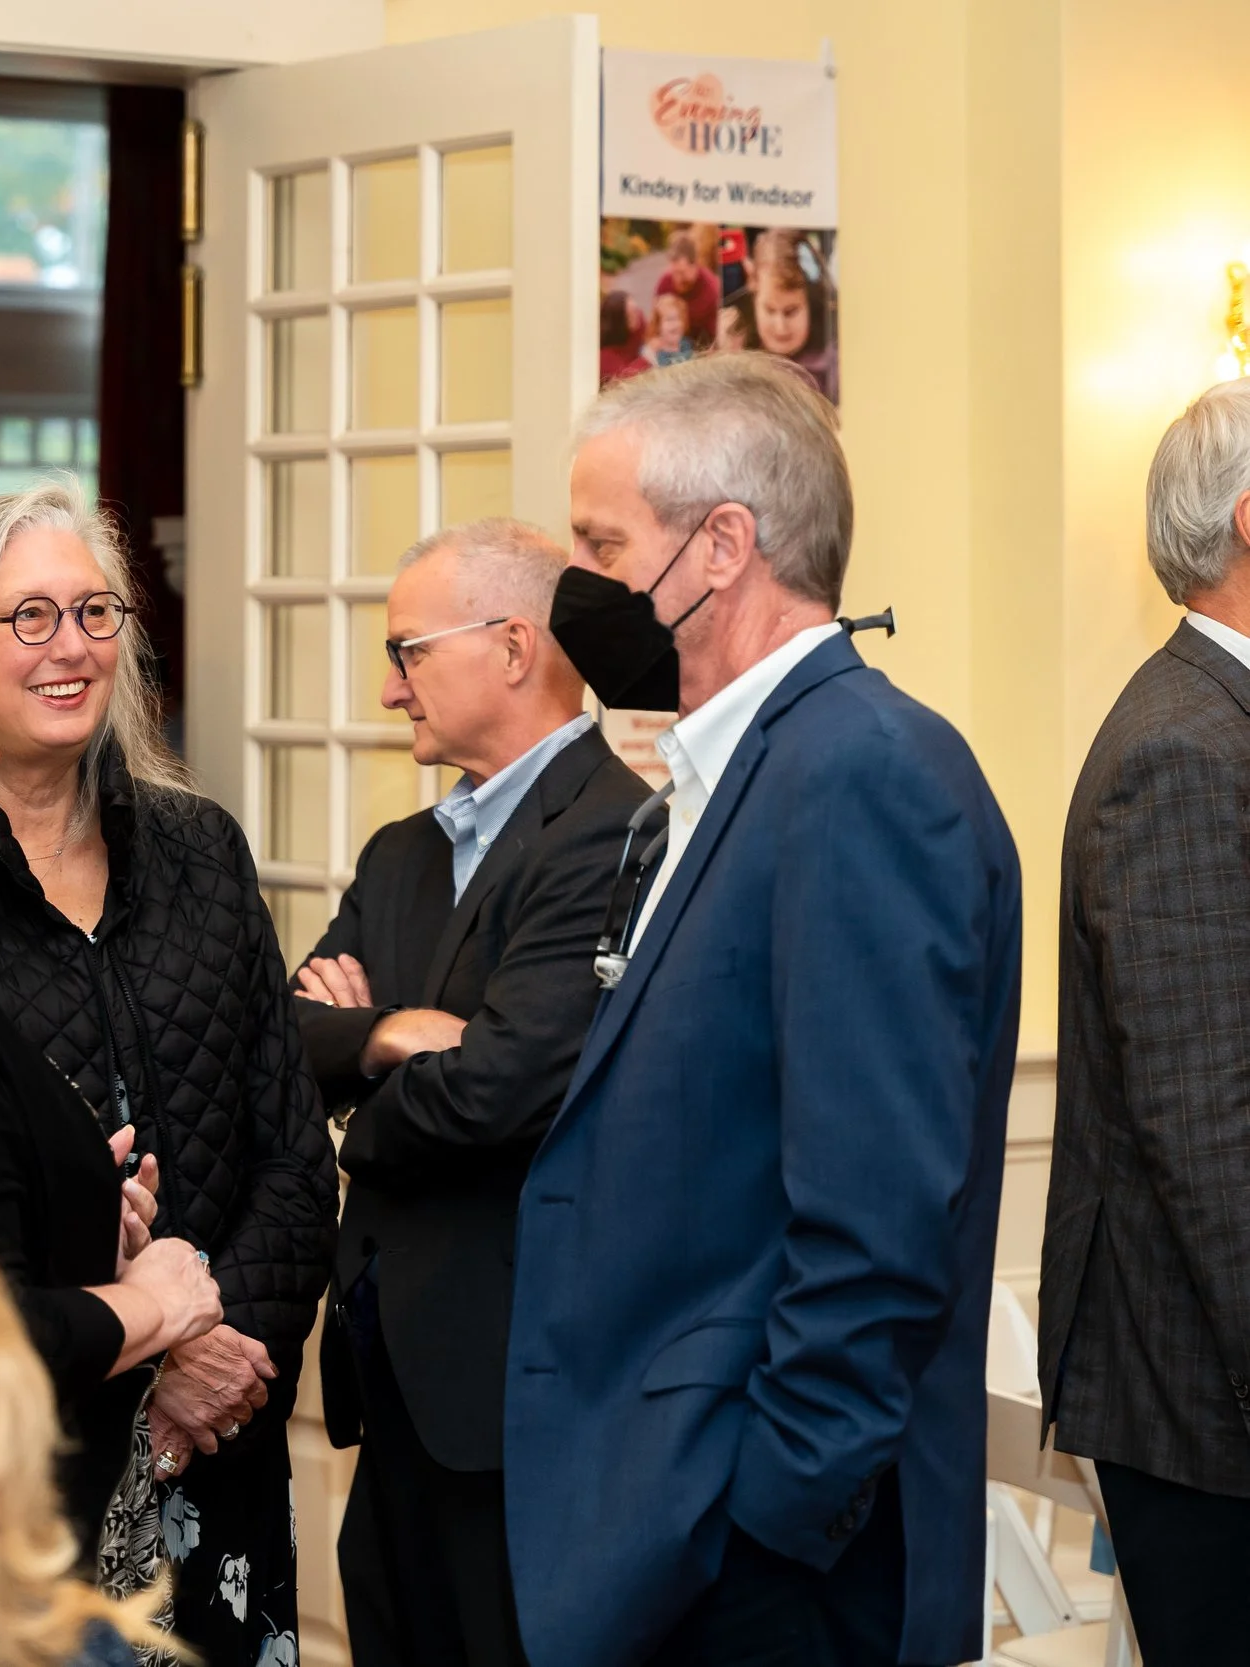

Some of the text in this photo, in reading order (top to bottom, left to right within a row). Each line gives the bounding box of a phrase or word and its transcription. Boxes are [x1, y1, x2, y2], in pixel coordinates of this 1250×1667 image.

[689, 120, 783, 157] HOPE
[692, 179, 721, 202] for
[727, 182, 814, 207] Windsor
